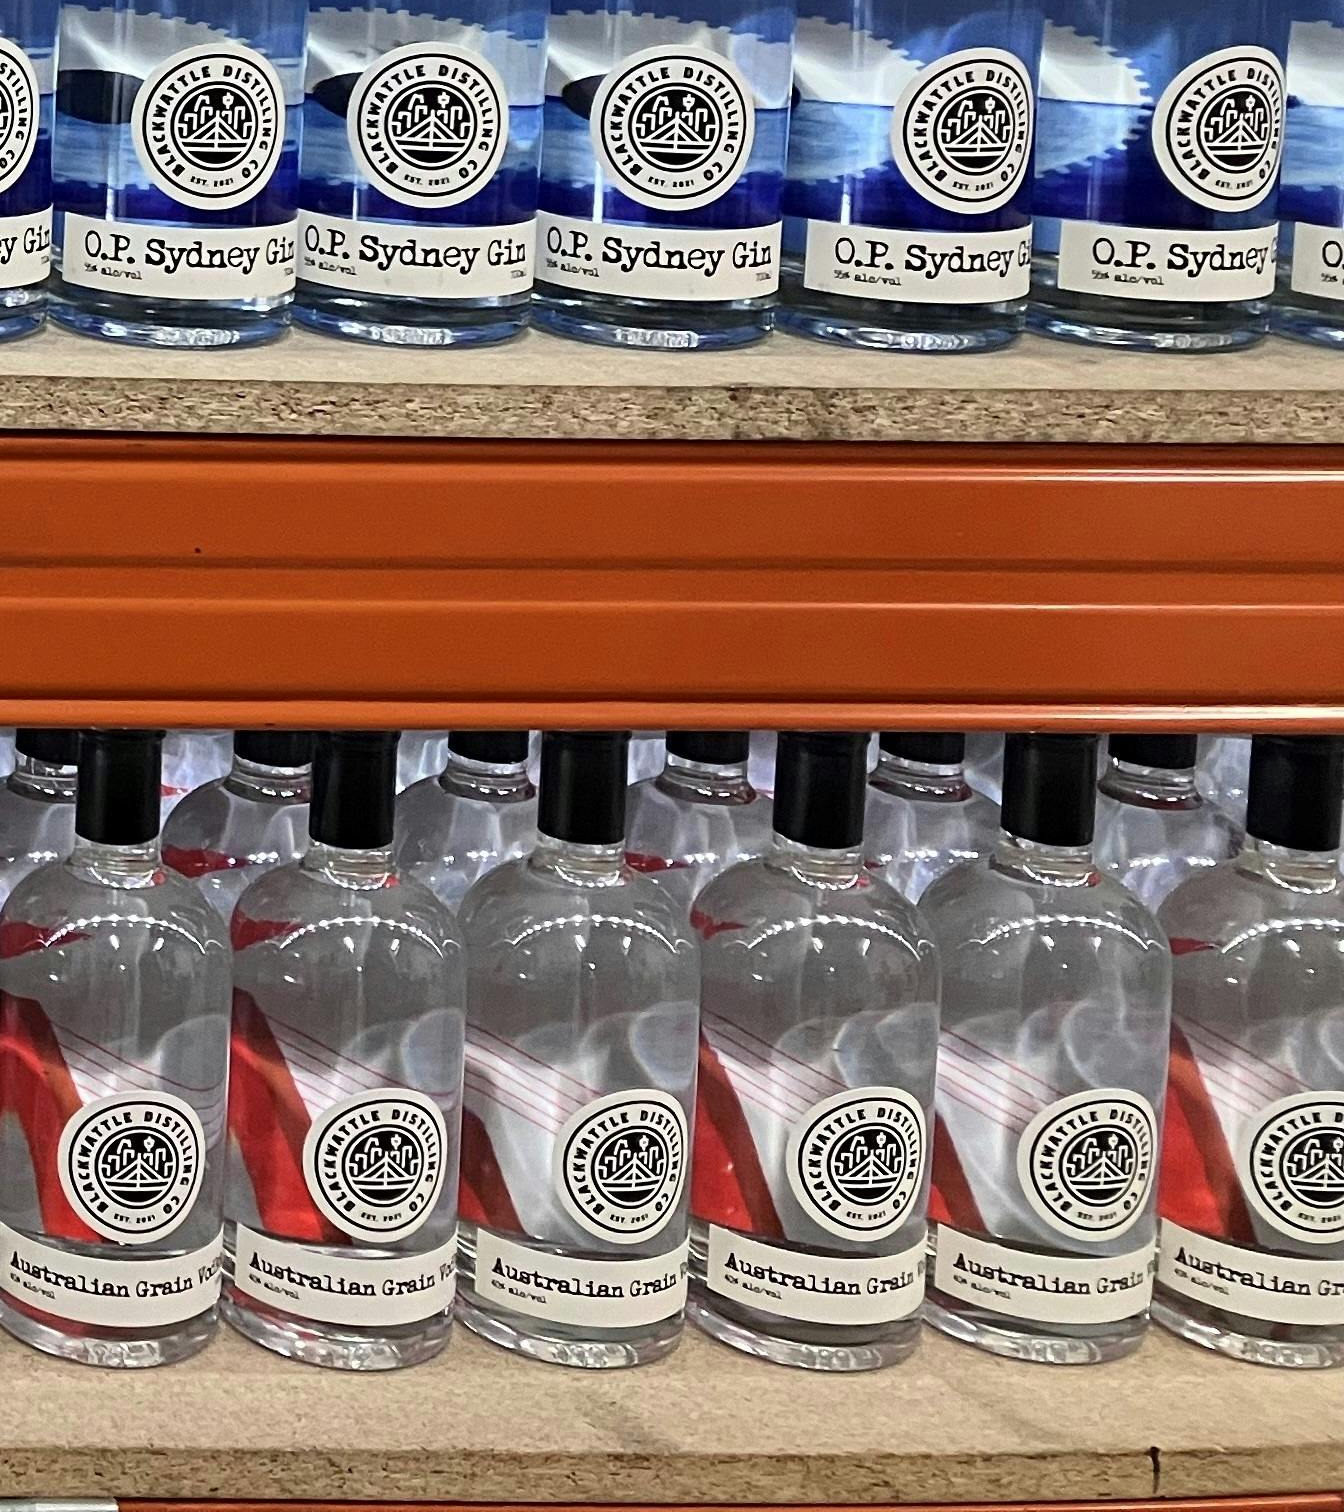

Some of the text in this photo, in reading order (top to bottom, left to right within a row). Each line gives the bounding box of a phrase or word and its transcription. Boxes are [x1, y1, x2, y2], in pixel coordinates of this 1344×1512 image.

[0, 150, 15, 169] CO
[85, 230, 135, 264] O.P.
[145, 239, 260, 275] Sydney
[305, 226, 525, 275] O.P. Sydney Gin
[546, 228, 771, 277] O.P. Sydney Gin
[835, 237, 1014, 279] O.P. Sydney
[1093, 238, 1268, 278] O.P. Sydney
[76, 1111, 194, 1215] BLACKWATTLE DISTILLING CO
[11, 1251, 129, 1297] Australian
[135, 1274, 193, 1298] Grain
[249, 1252, 376, 1296] Australian
[382, 1272, 435, 1296] Grain
[491, 1257, 624, 1298] Australian
[724, 1253, 860, 1296] Australian
[952, 1253, 1091, 1296] Australian
[1175, 1247, 1311, 1295] Australian
